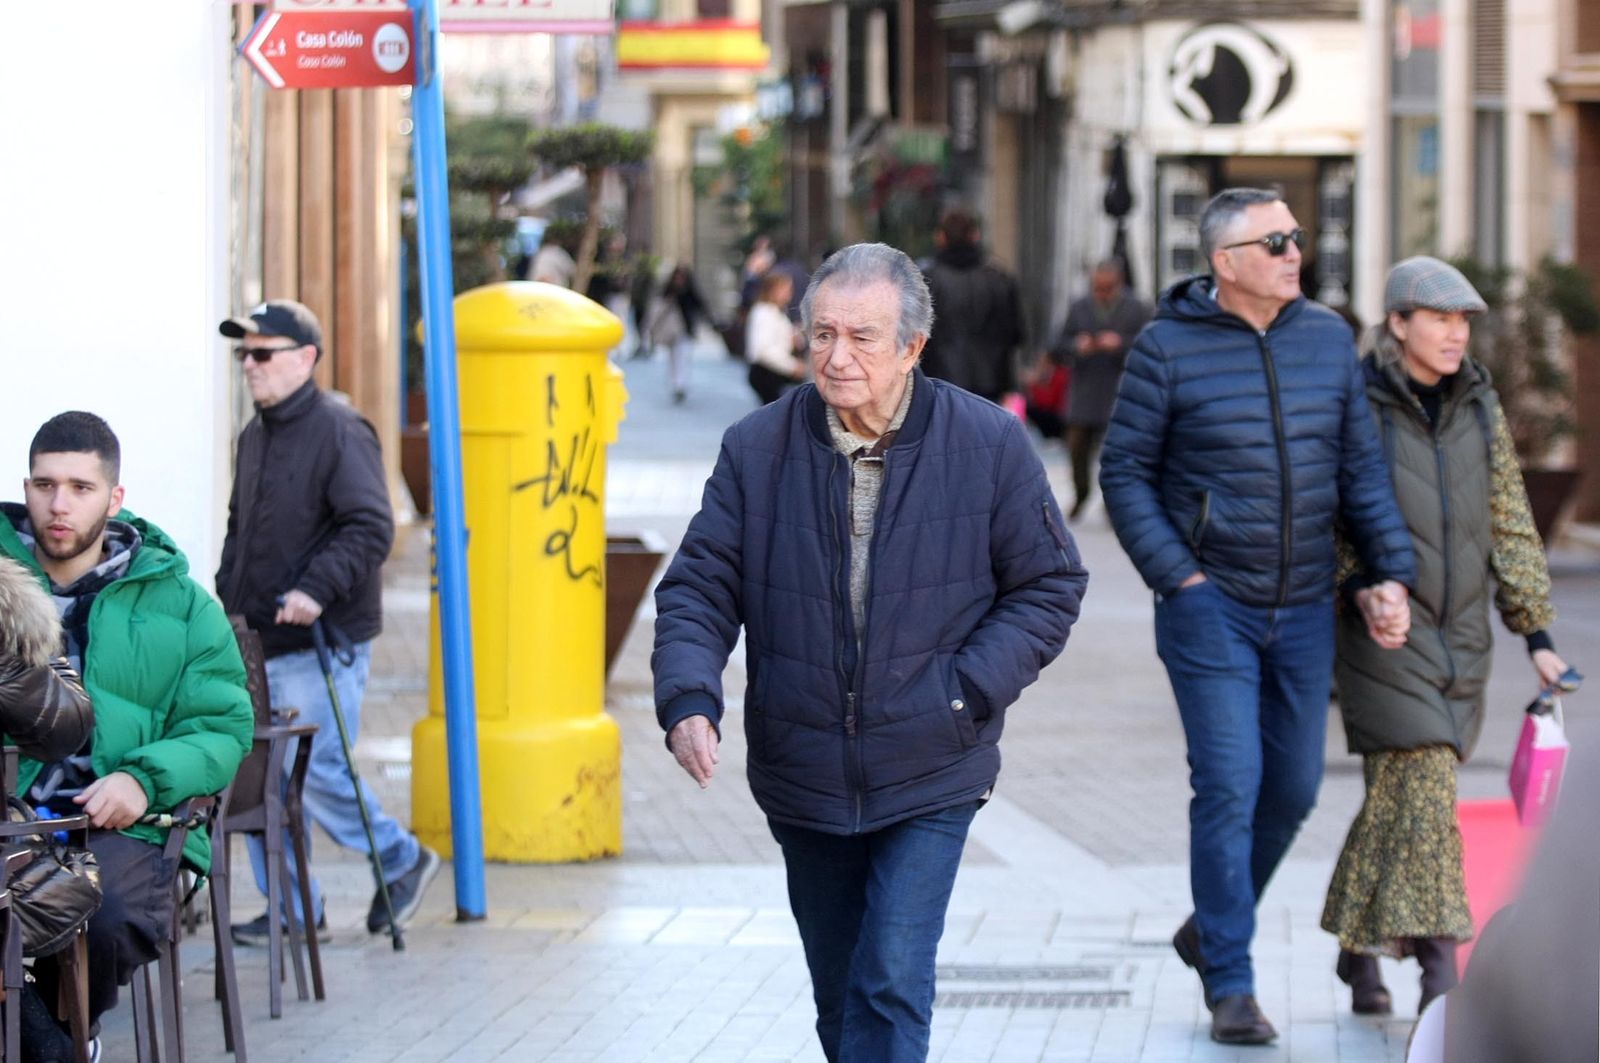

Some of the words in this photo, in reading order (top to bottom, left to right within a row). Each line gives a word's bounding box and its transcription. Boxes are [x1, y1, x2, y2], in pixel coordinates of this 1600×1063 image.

[296, 31, 326, 48] Casa
[328, 30, 363, 48] Colón
[322, 54, 346, 68] Colón
